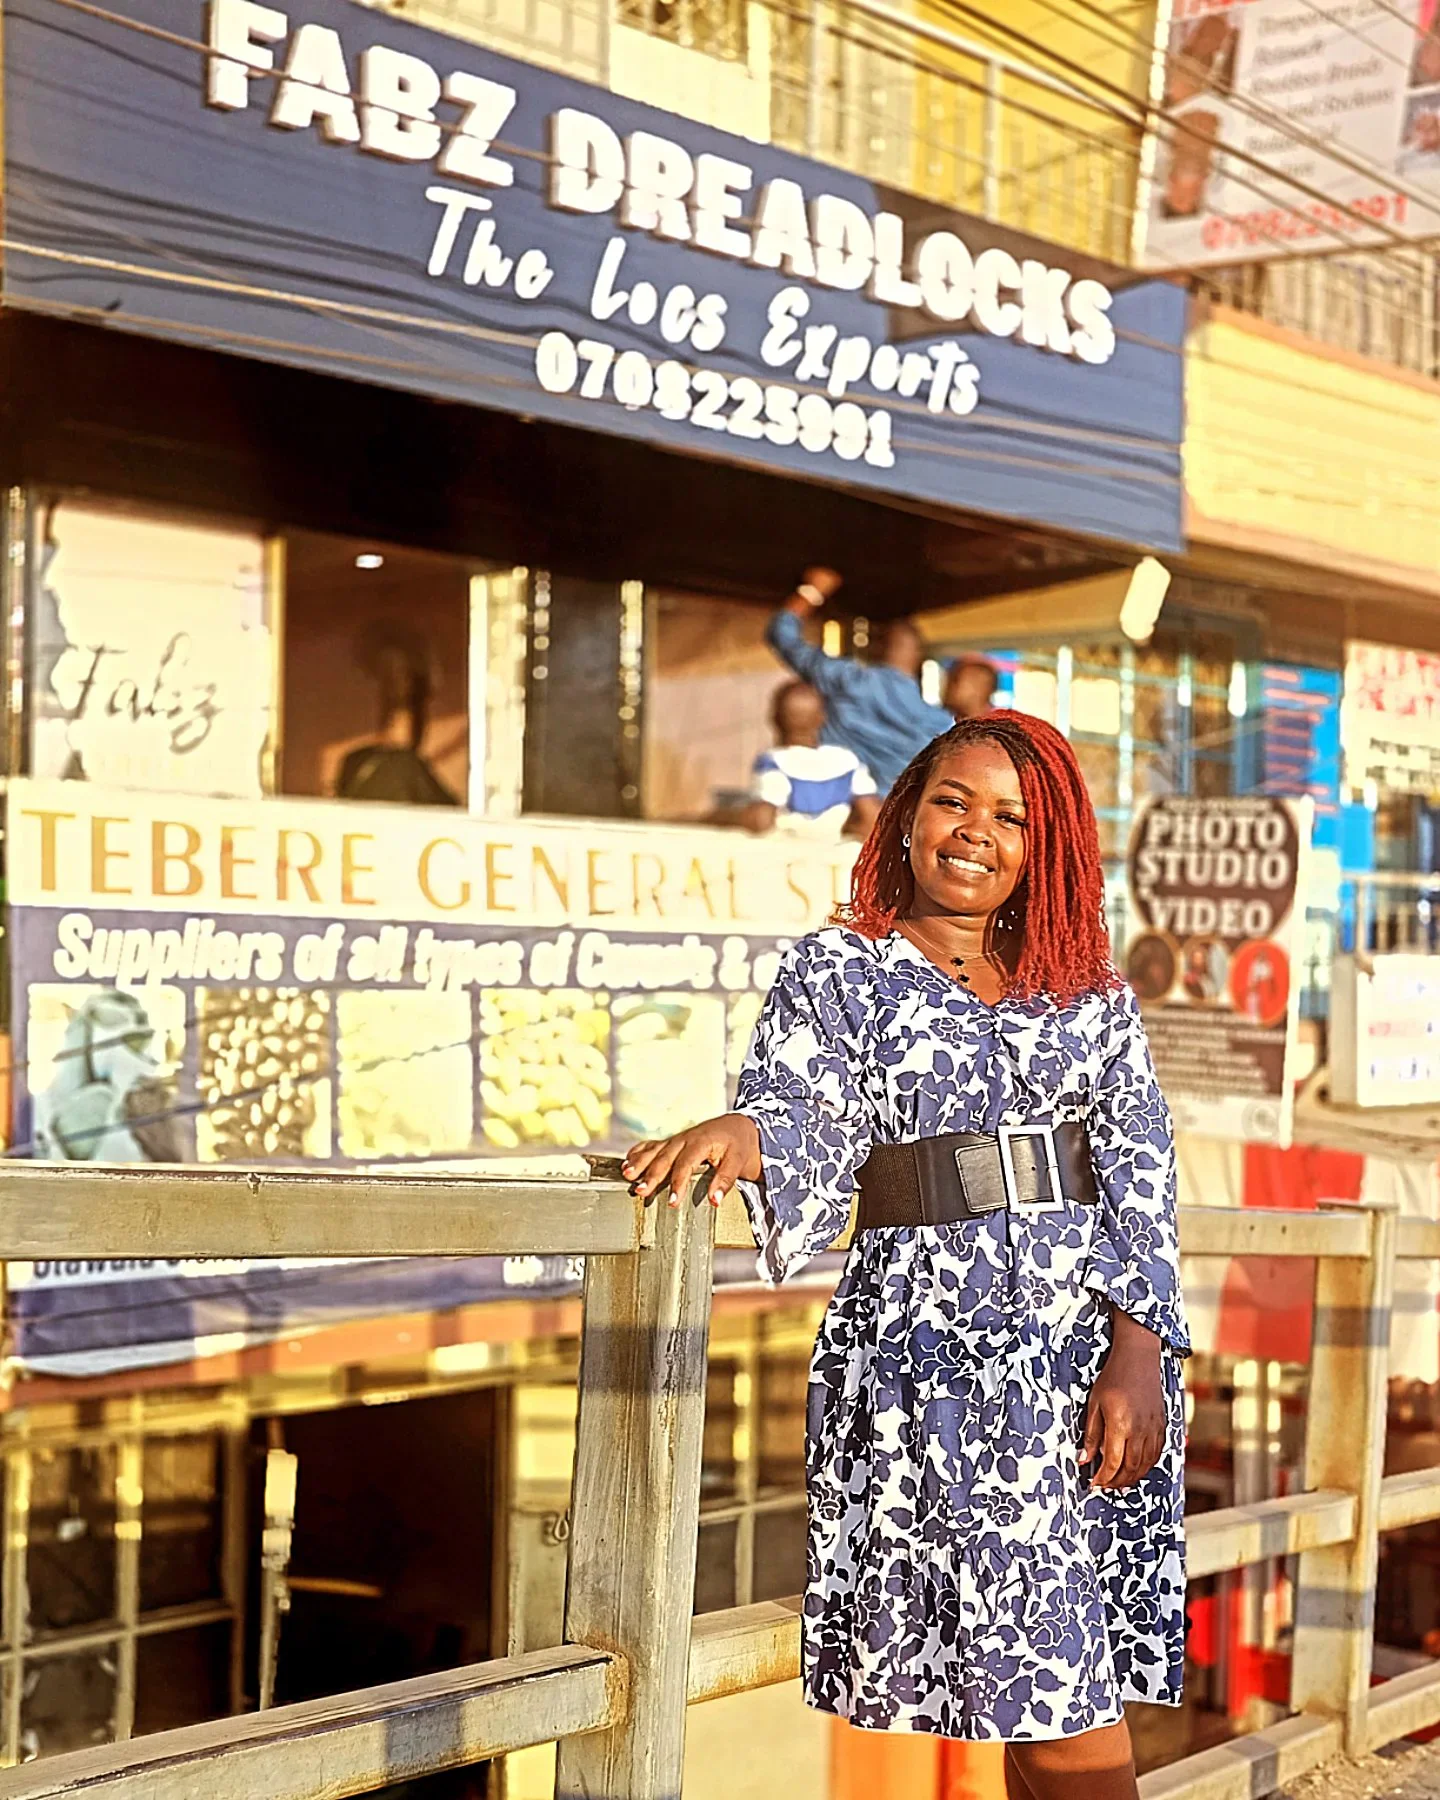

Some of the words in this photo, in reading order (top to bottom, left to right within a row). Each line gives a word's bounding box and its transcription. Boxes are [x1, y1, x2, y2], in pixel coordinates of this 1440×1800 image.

[207, 0, 516, 188] FABZ
[550, 108, 1116, 365] DREADLOCKS
[425, 186, 554, 299] The
[760, 286, 981, 415] Experts
[21, 808, 378, 905] TEBERE
[417, 837, 750, 920] GENERAL
[1137, 848, 1291, 890] STUDIO
[1147, 812, 1287, 850] PHOTO
[53, 912, 286, 988] Suppliers
[294, 922, 345, 982] of
[347, 925, 409, 982] all
[413, 928, 525, 990] types
[529, 931, 576, 987] of
[718, 936, 751, 990] &
[1151, 897, 1272, 939] VIDEO
